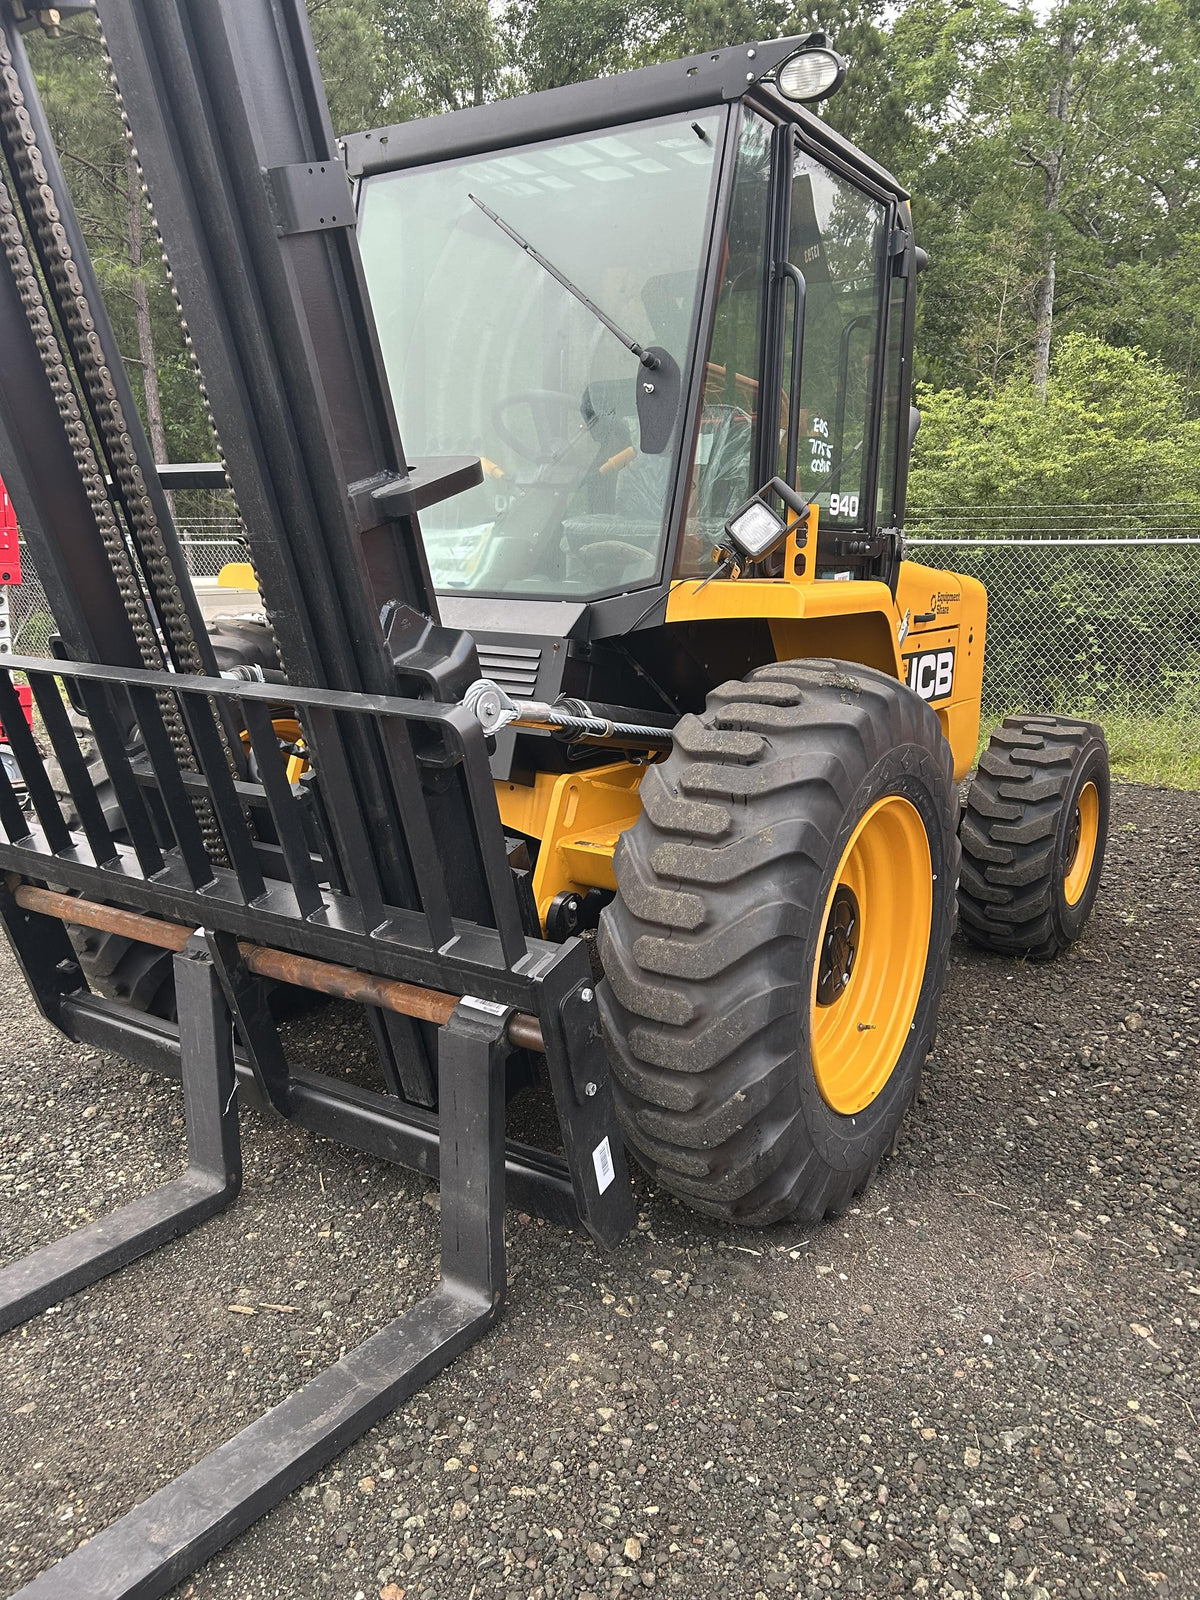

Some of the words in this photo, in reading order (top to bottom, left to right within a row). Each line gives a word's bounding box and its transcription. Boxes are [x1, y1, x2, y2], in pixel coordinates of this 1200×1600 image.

[829, 493, 859, 517] 940
[937, 591, 960, 604] Equipment
[936, 604, 949, 614] Share
